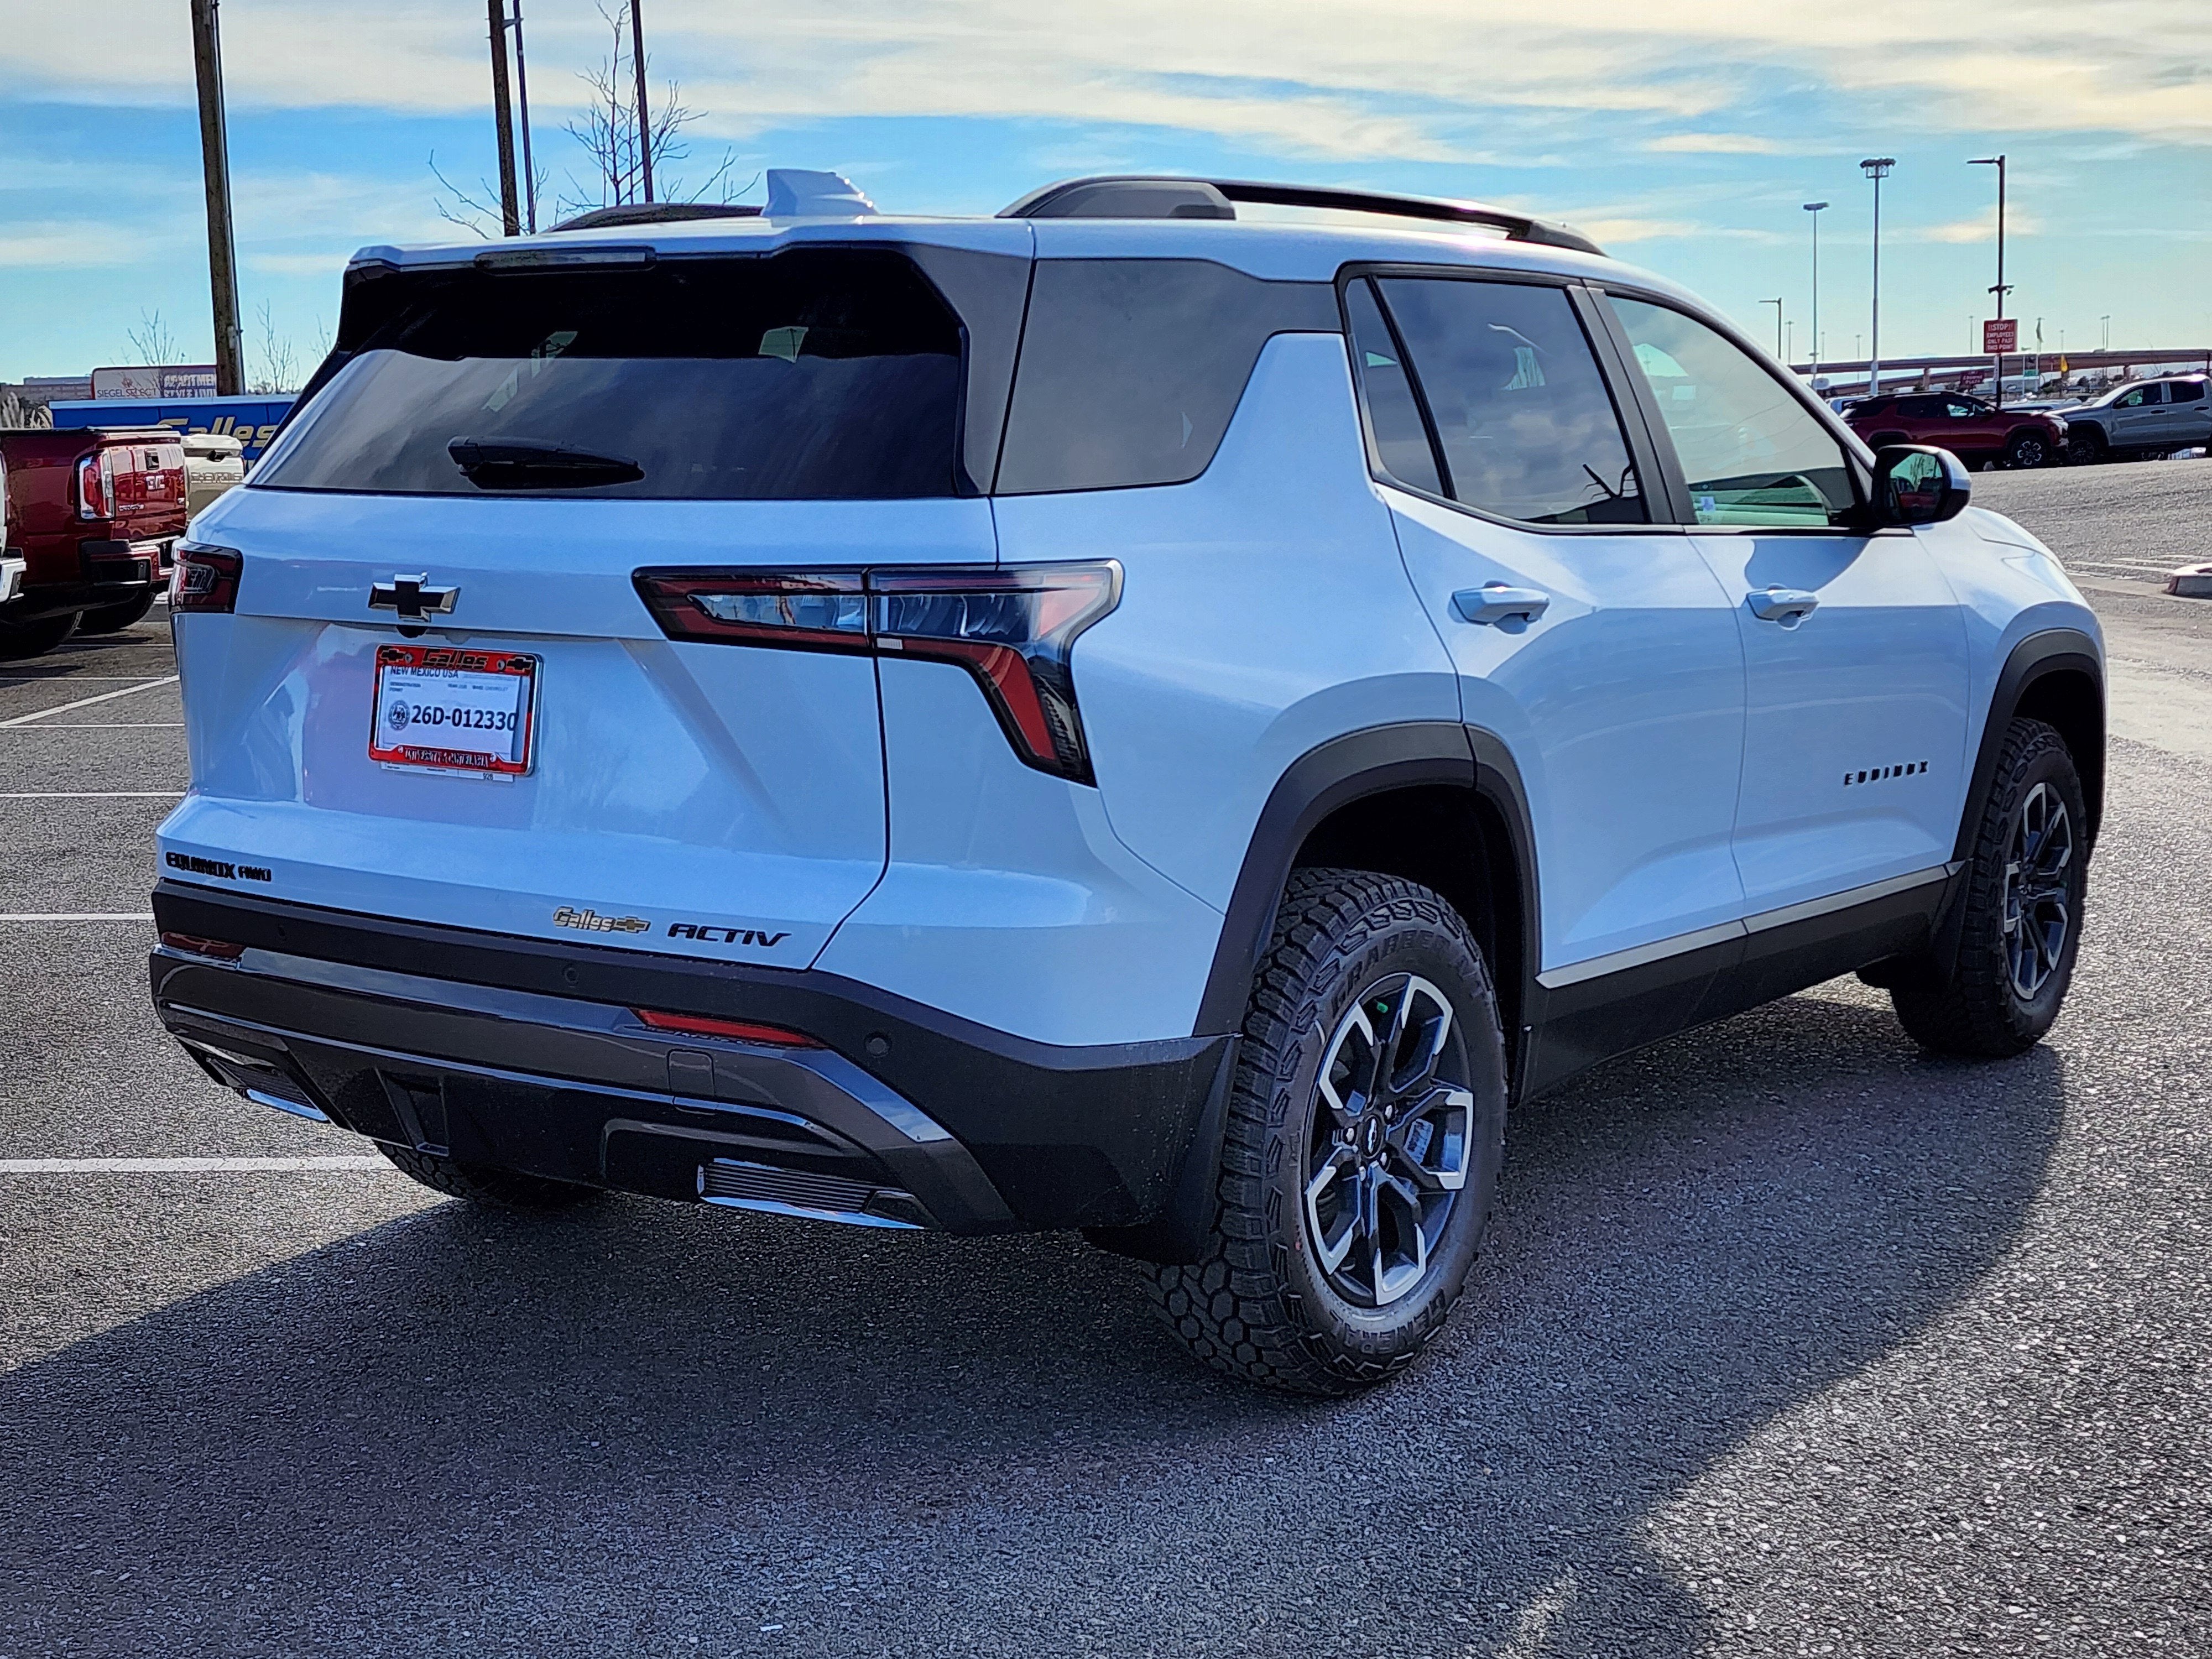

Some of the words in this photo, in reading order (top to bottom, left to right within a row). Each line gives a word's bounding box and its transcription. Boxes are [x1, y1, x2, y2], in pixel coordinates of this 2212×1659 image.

[97, 389, 126, 398] SIEGEL
[421, 648, 489, 671] Galles
[390, 667, 409, 676] NEW
[410, 667, 441, 678] MEXICO
[442, 670, 459, 679] USA
[410, 705, 518, 732] 26D-012330
[553, 906, 615, 932] Galles
[667, 922, 792, 947] ACTIV
